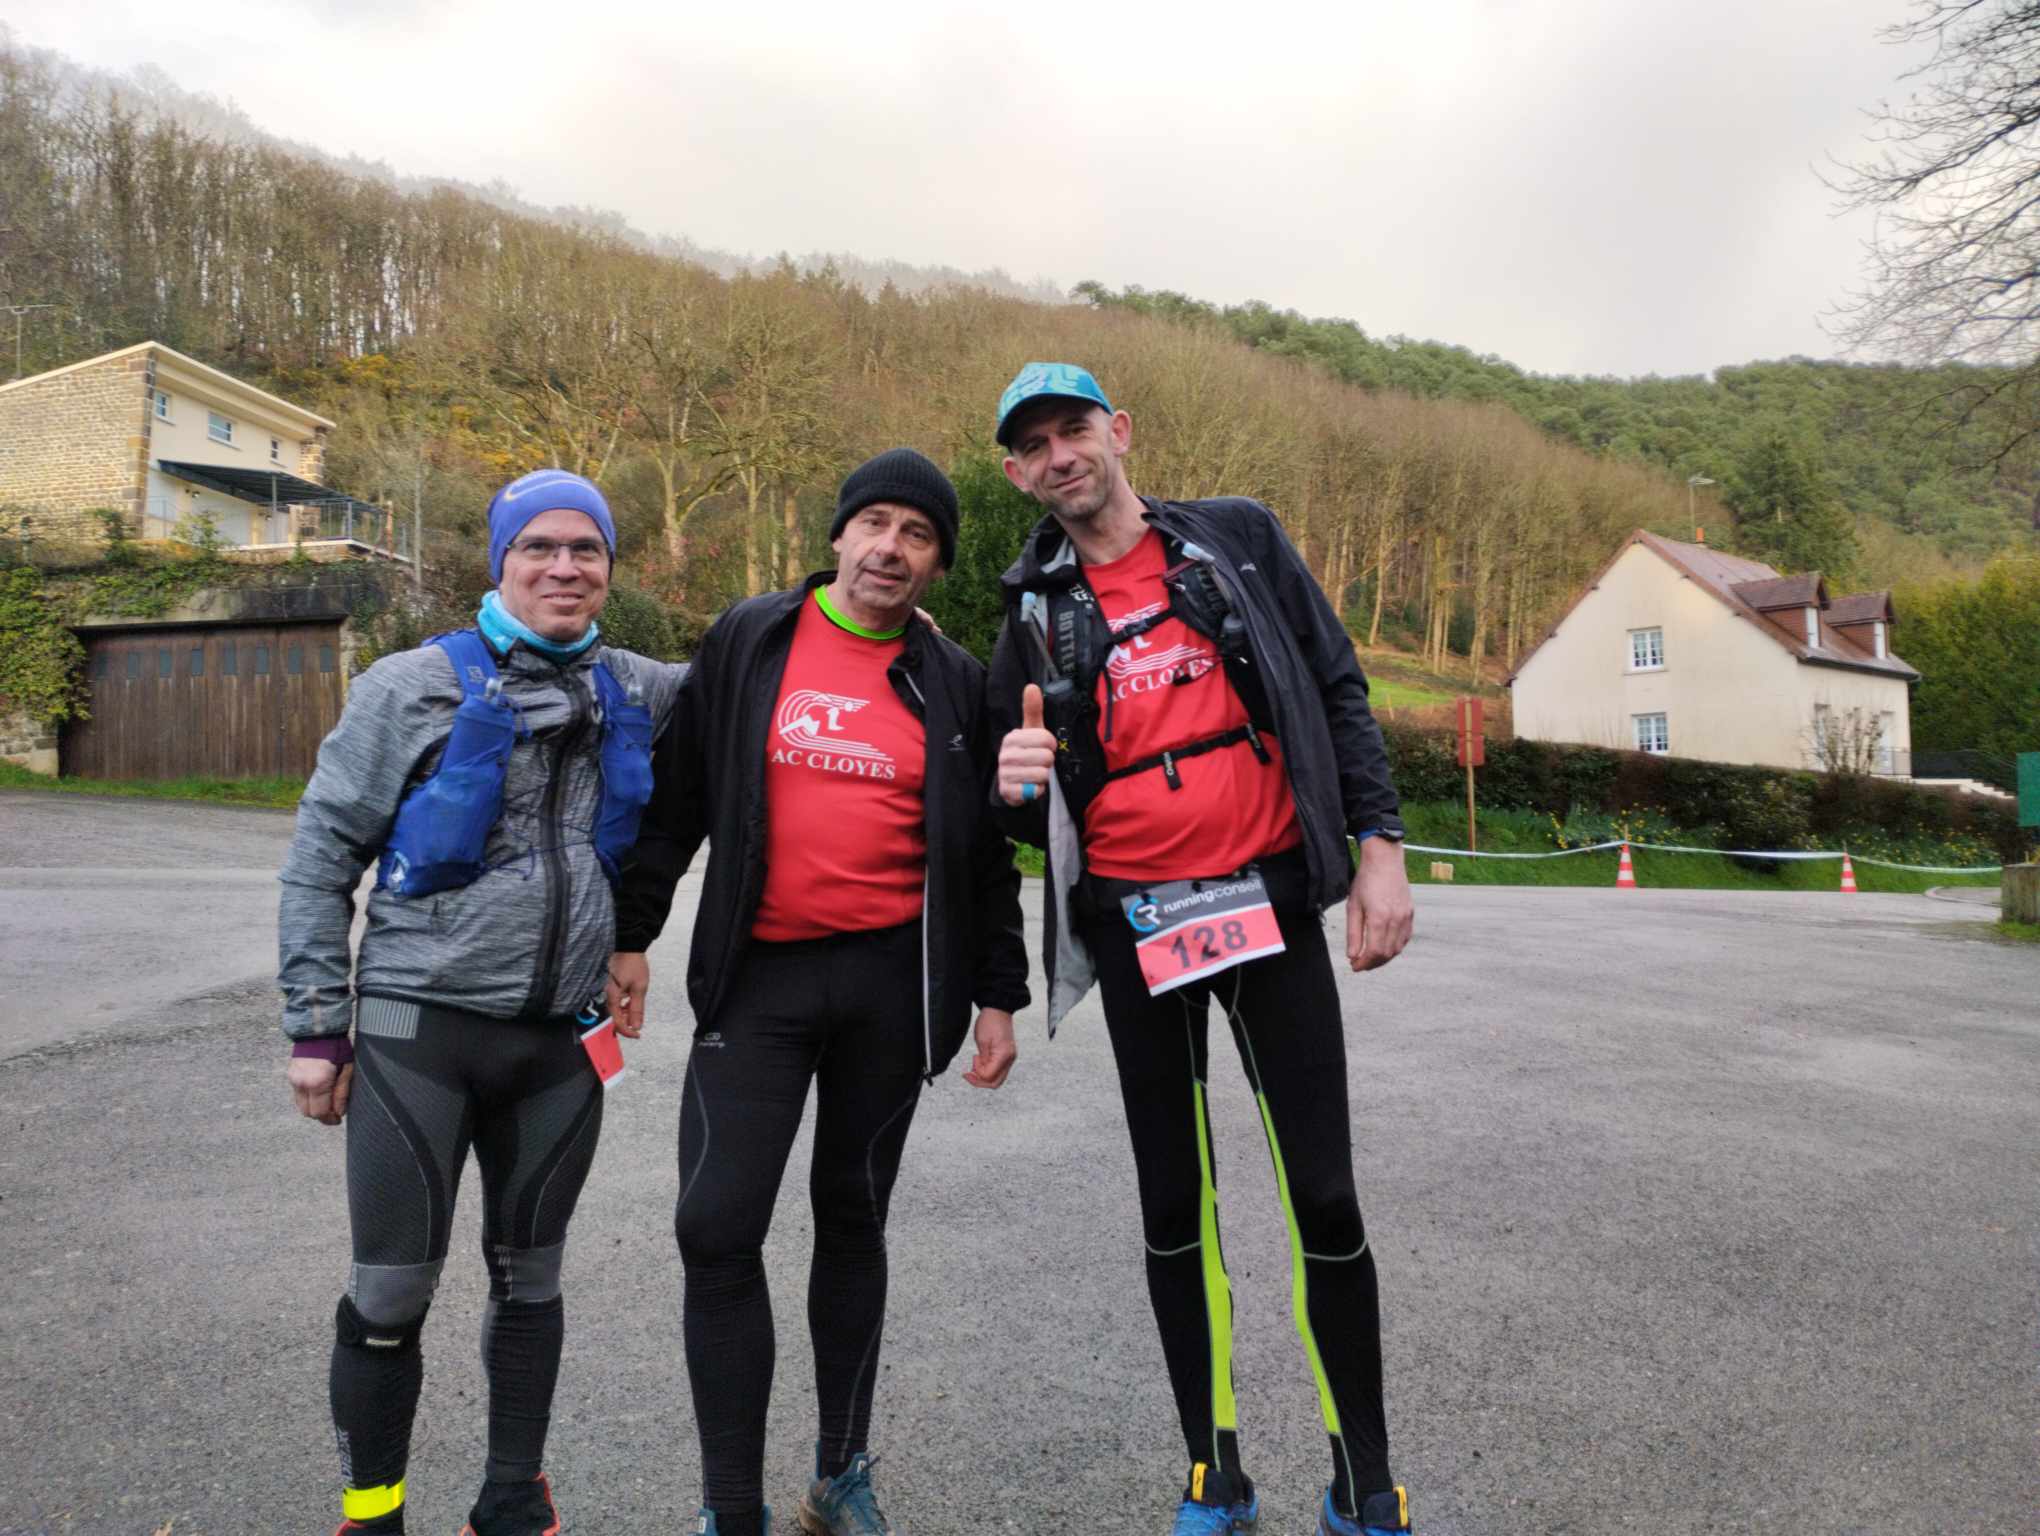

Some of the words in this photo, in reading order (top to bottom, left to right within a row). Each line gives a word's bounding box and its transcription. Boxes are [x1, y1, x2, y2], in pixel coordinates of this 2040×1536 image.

[771, 748, 803, 765] AC
[807, 752, 897, 780] CLOYES
[1171, 920, 1248, 969] 128
